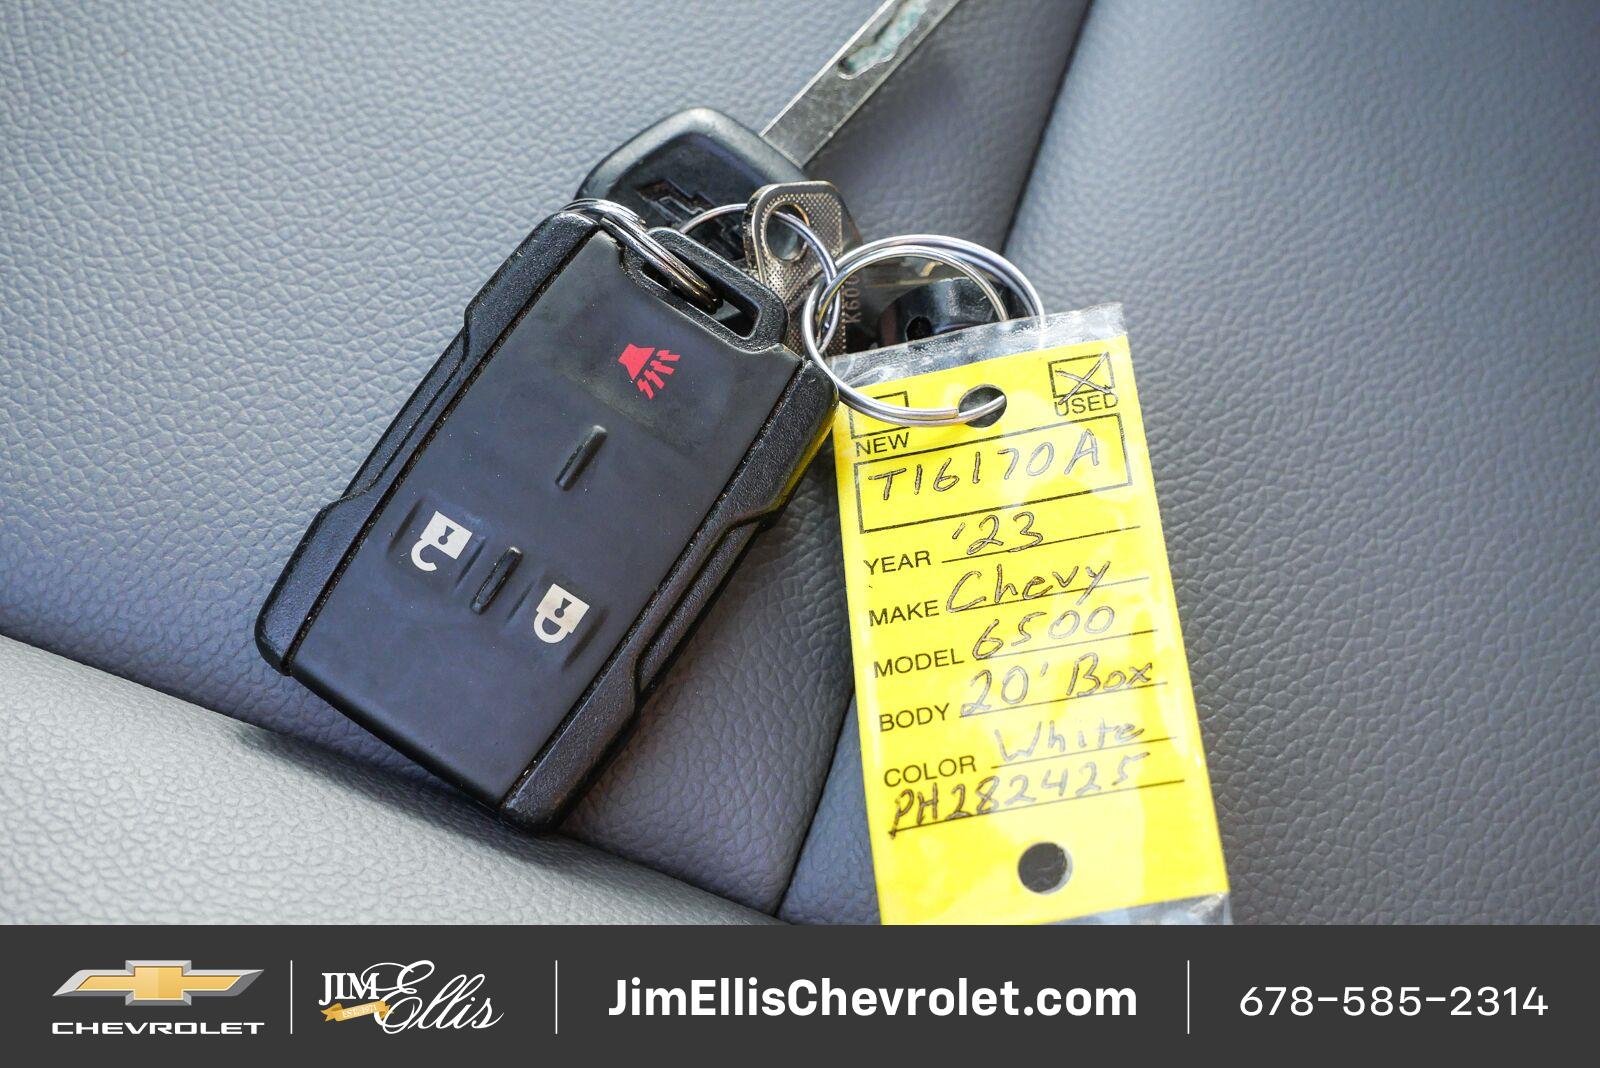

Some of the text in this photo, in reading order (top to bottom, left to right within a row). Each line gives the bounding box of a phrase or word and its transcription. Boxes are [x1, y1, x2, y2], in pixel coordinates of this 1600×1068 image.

[1054, 393, 1119, 417] USED
[855, 431, 910, 457] NEW
[868, 428, 1101, 501] T16170A
[863, 550, 932, 576] YEAR
[946, 561, 1112, 613] Chevy
[868, 600, 940, 627] MAKE
[972, 605, 1116, 661] 6500
[873, 648, 965, 679] MODEL
[1066, 652, 1154, 698] Box
[878, 702, 951, 733] BODY
[993, 717, 1146, 763] White
[883, 755, 977, 788] COLOR
